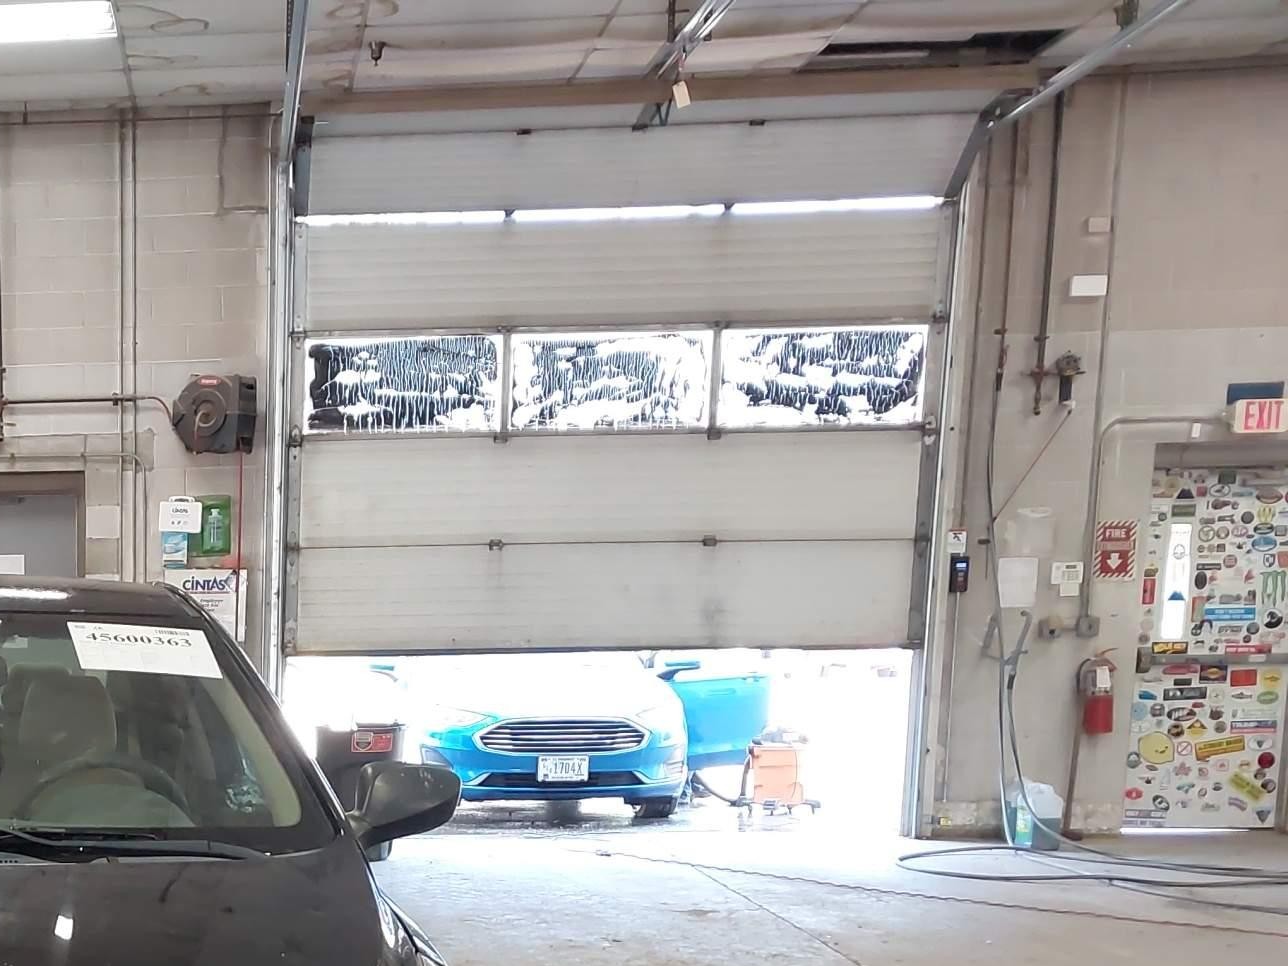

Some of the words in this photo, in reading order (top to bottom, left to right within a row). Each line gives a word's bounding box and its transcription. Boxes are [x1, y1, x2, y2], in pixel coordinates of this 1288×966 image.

[1243, 400, 1285, 430] EXIT
[1105, 528, 1128, 540] FIRE
[85, 632, 193, 648] 45600363
